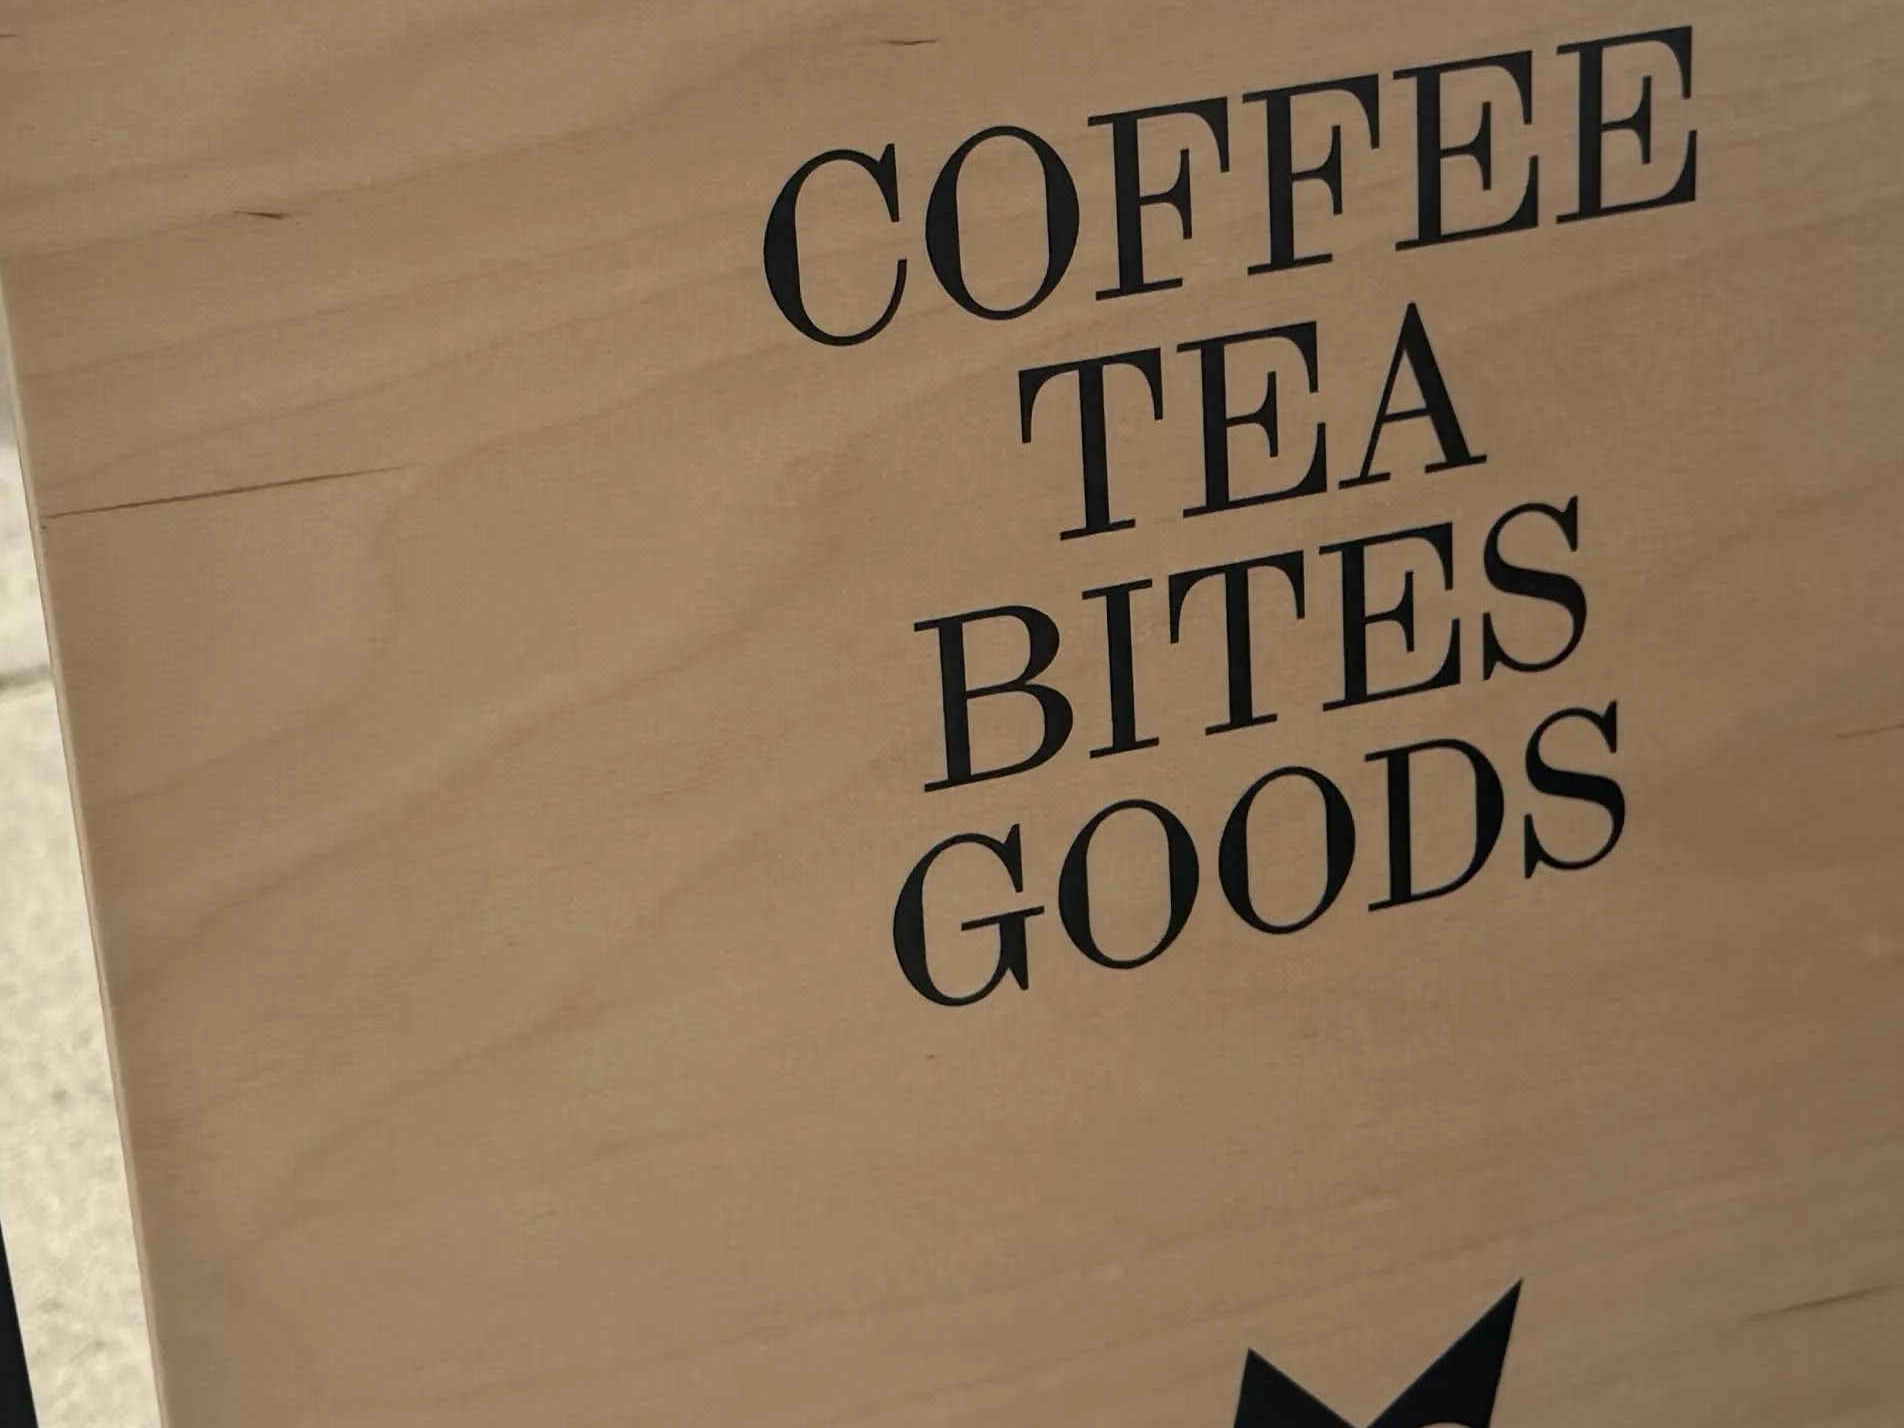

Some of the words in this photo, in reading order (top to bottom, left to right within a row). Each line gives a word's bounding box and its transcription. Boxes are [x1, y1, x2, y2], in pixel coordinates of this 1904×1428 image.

[763, 26, 1698, 347] COFFEE
[1018, 302, 1488, 541] TEA
[914, 496, 1588, 793] BITES
[892, 701, 1626, 1007] GOODS
